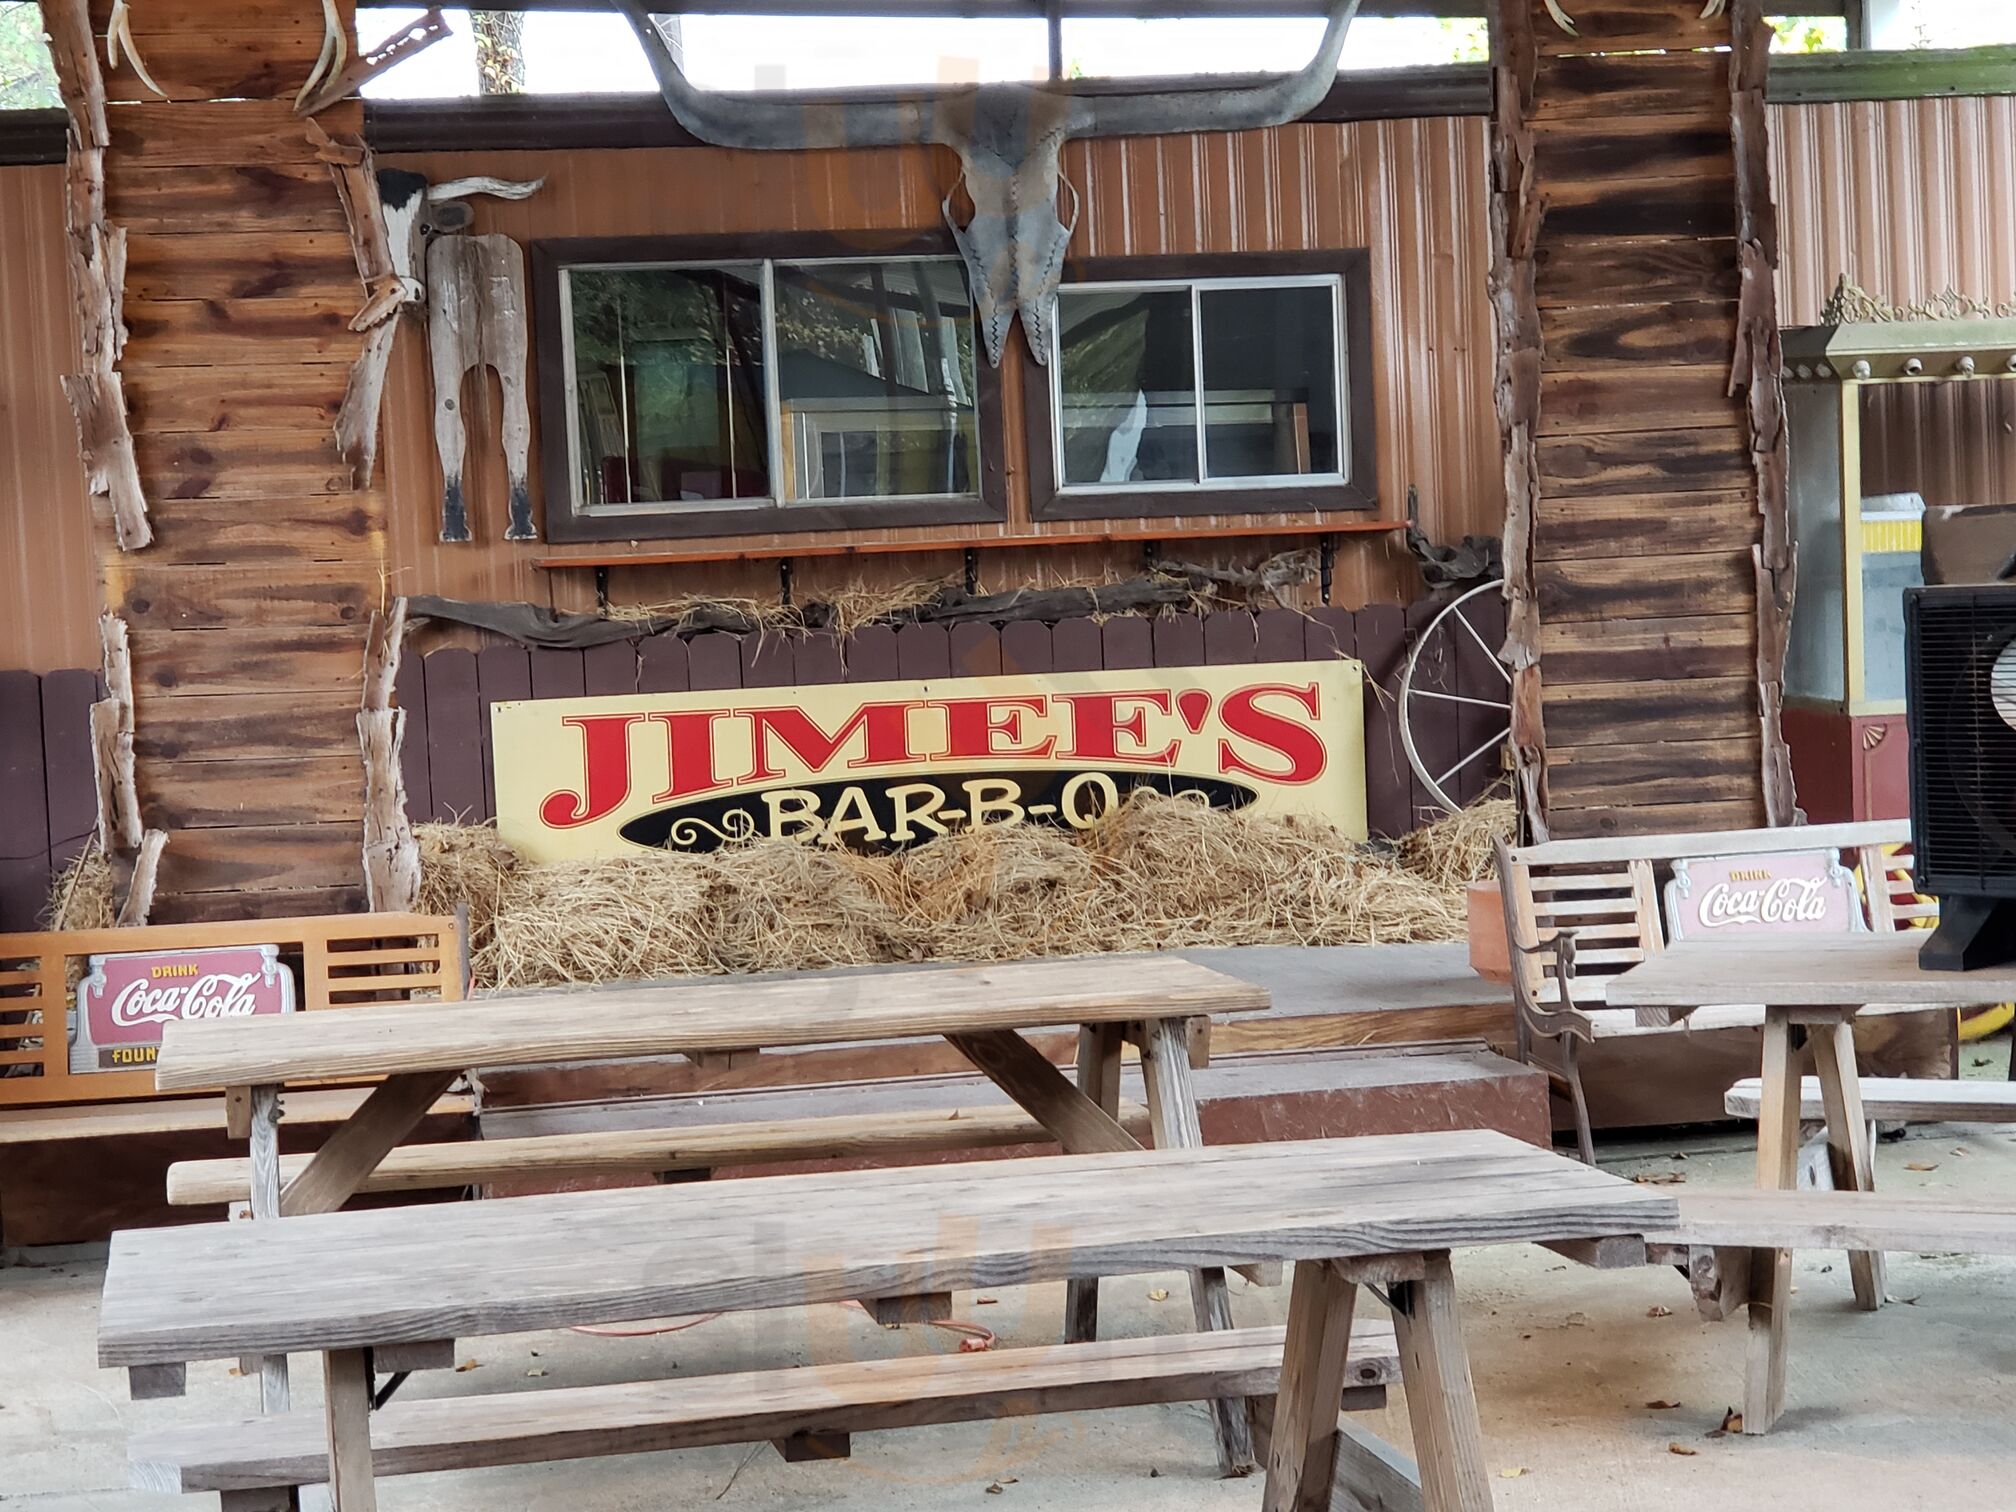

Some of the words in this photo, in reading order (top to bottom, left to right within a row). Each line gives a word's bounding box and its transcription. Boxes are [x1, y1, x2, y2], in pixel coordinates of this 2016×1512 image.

[539, 682, 1329, 830] JIMEE'S
[760, 772, 1119, 844] BAR-B-Q
[1729, 869, 1773, 882] DRINK
[1699, 876, 1828, 928] Coca-Cola
[151, 963, 199, 978] DRINK
[111, 972, 261, 1027] Coca-Cola
[111, 1046, 162, 1064] FOUN
